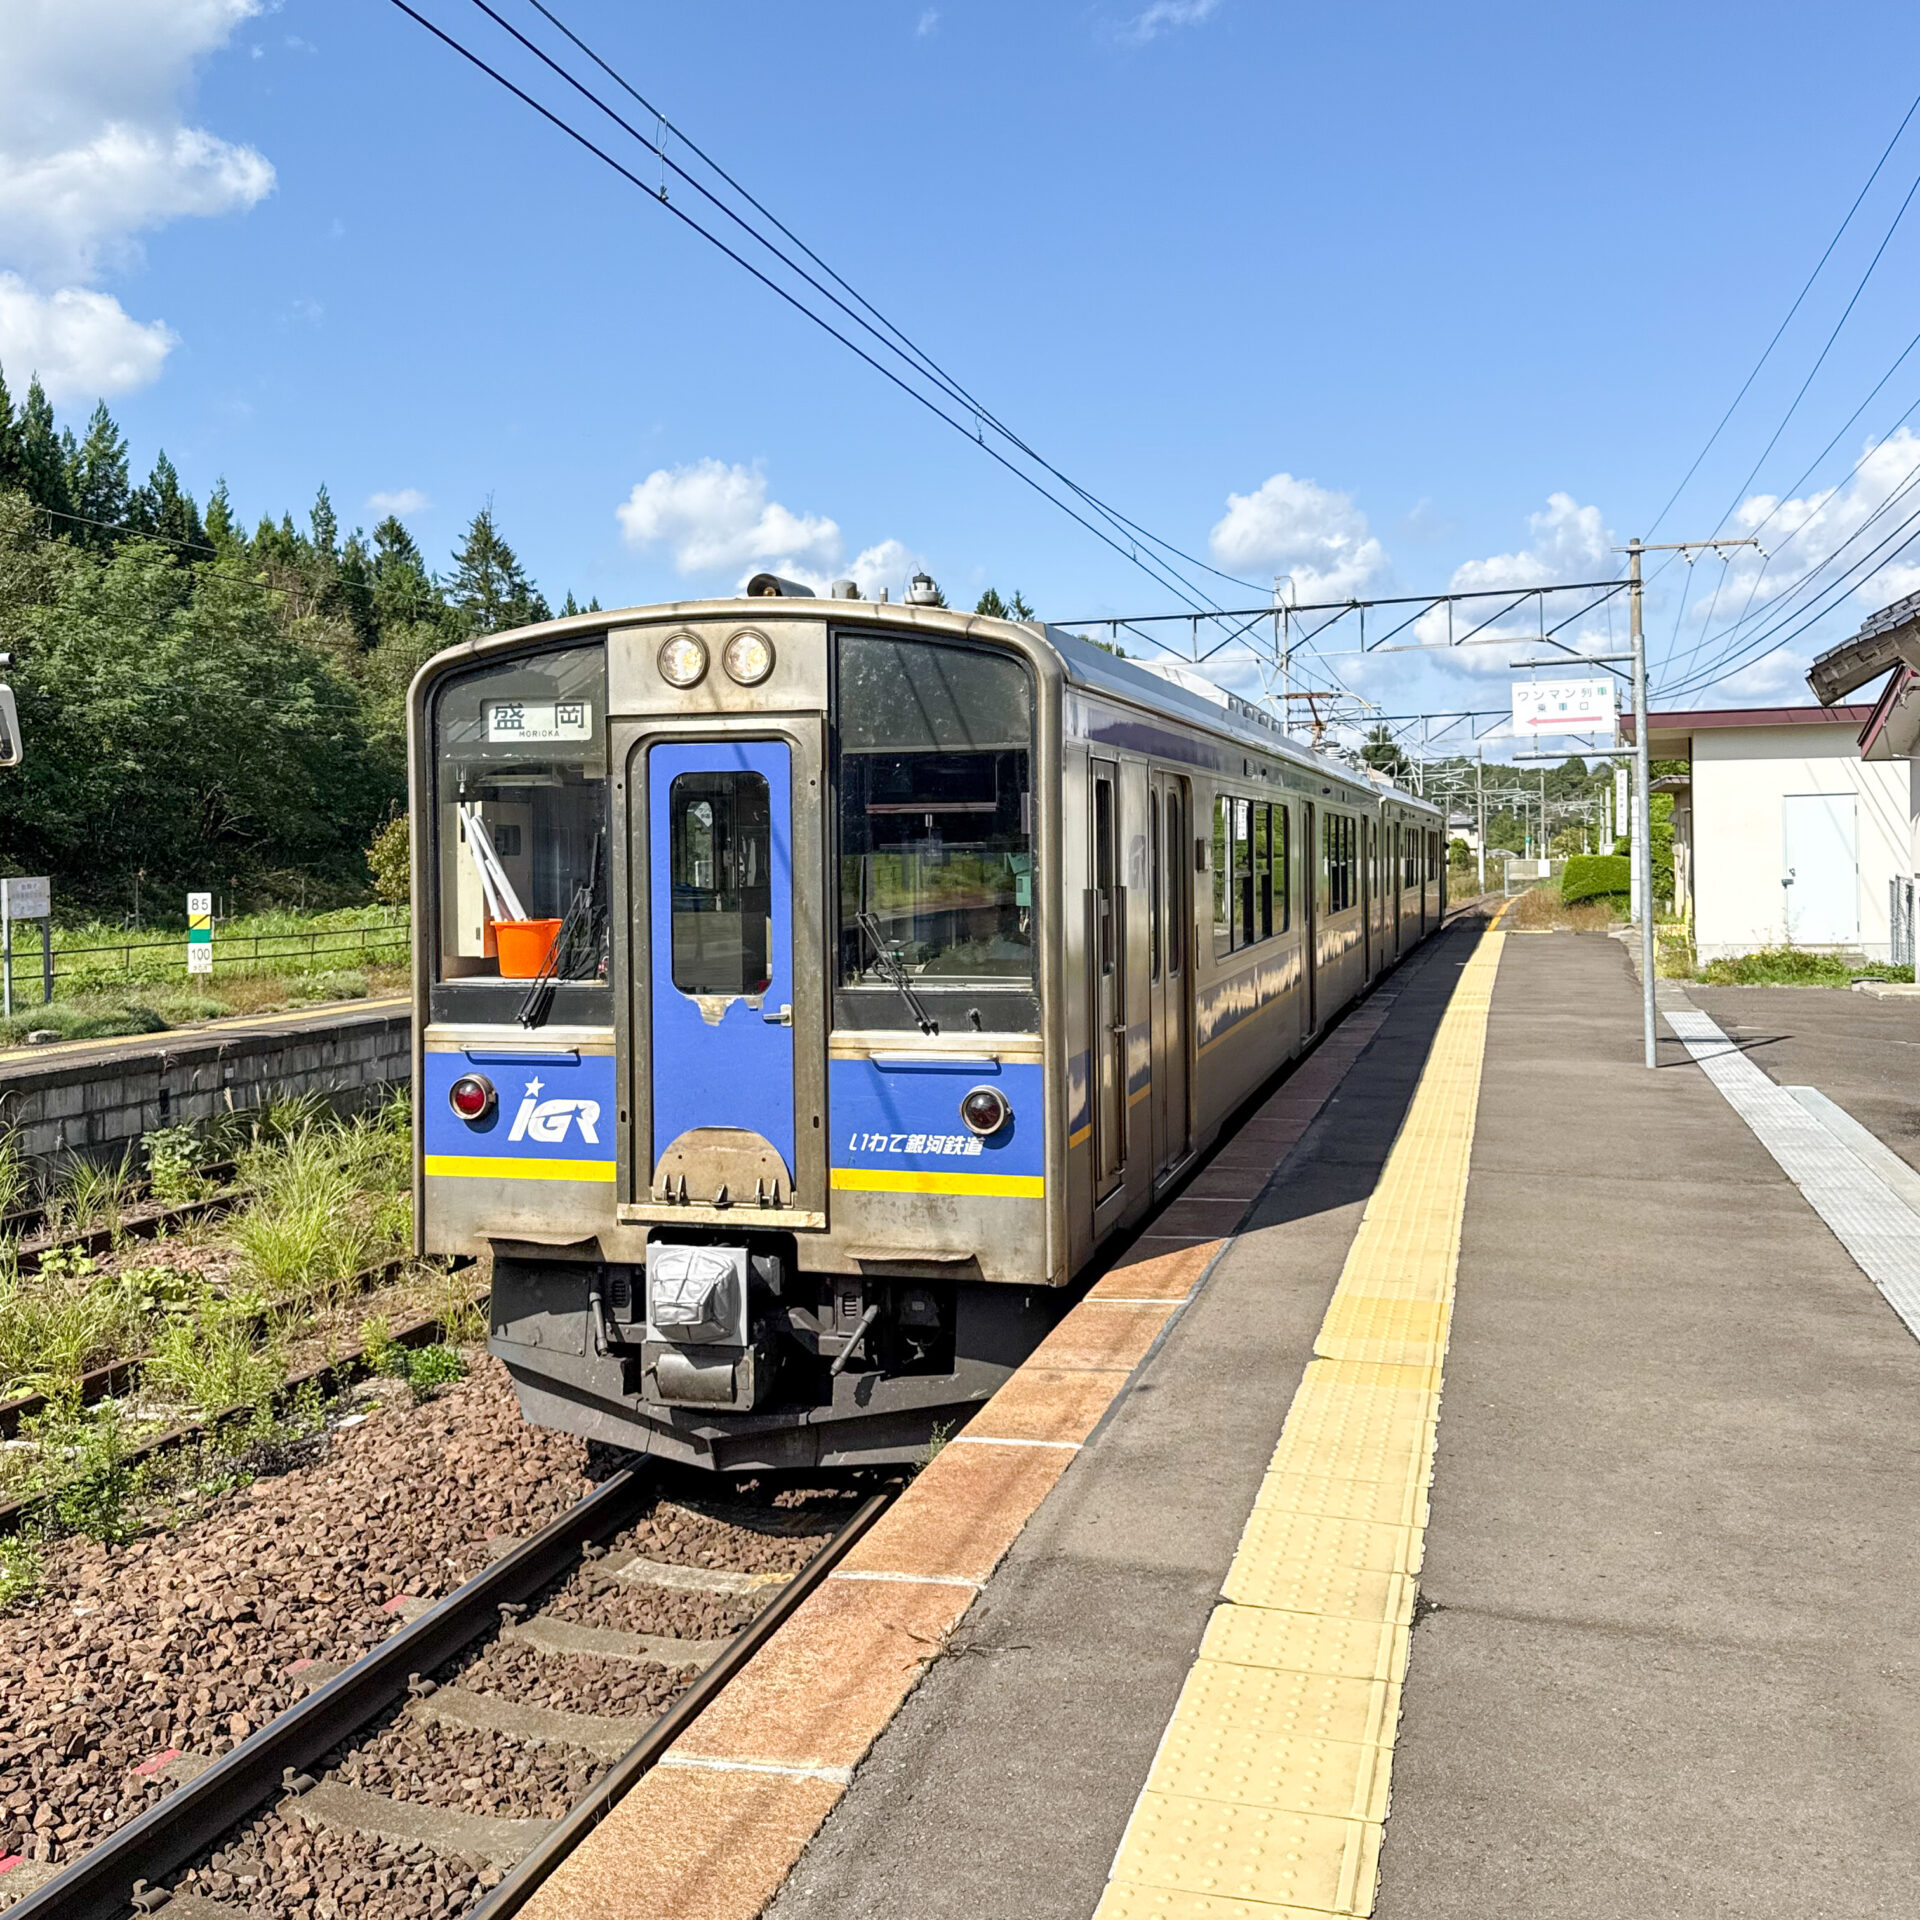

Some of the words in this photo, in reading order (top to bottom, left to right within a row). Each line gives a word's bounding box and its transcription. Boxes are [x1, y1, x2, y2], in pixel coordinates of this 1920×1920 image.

[494, 703, 584, 730] 盛岡
[519, 730, 560, 738] MORIOKA
[192, 899, 208, 910] 85
[192, 949, 210, 960] 100
[848, 1132, 985, 1156] いわて銀河鉄道
